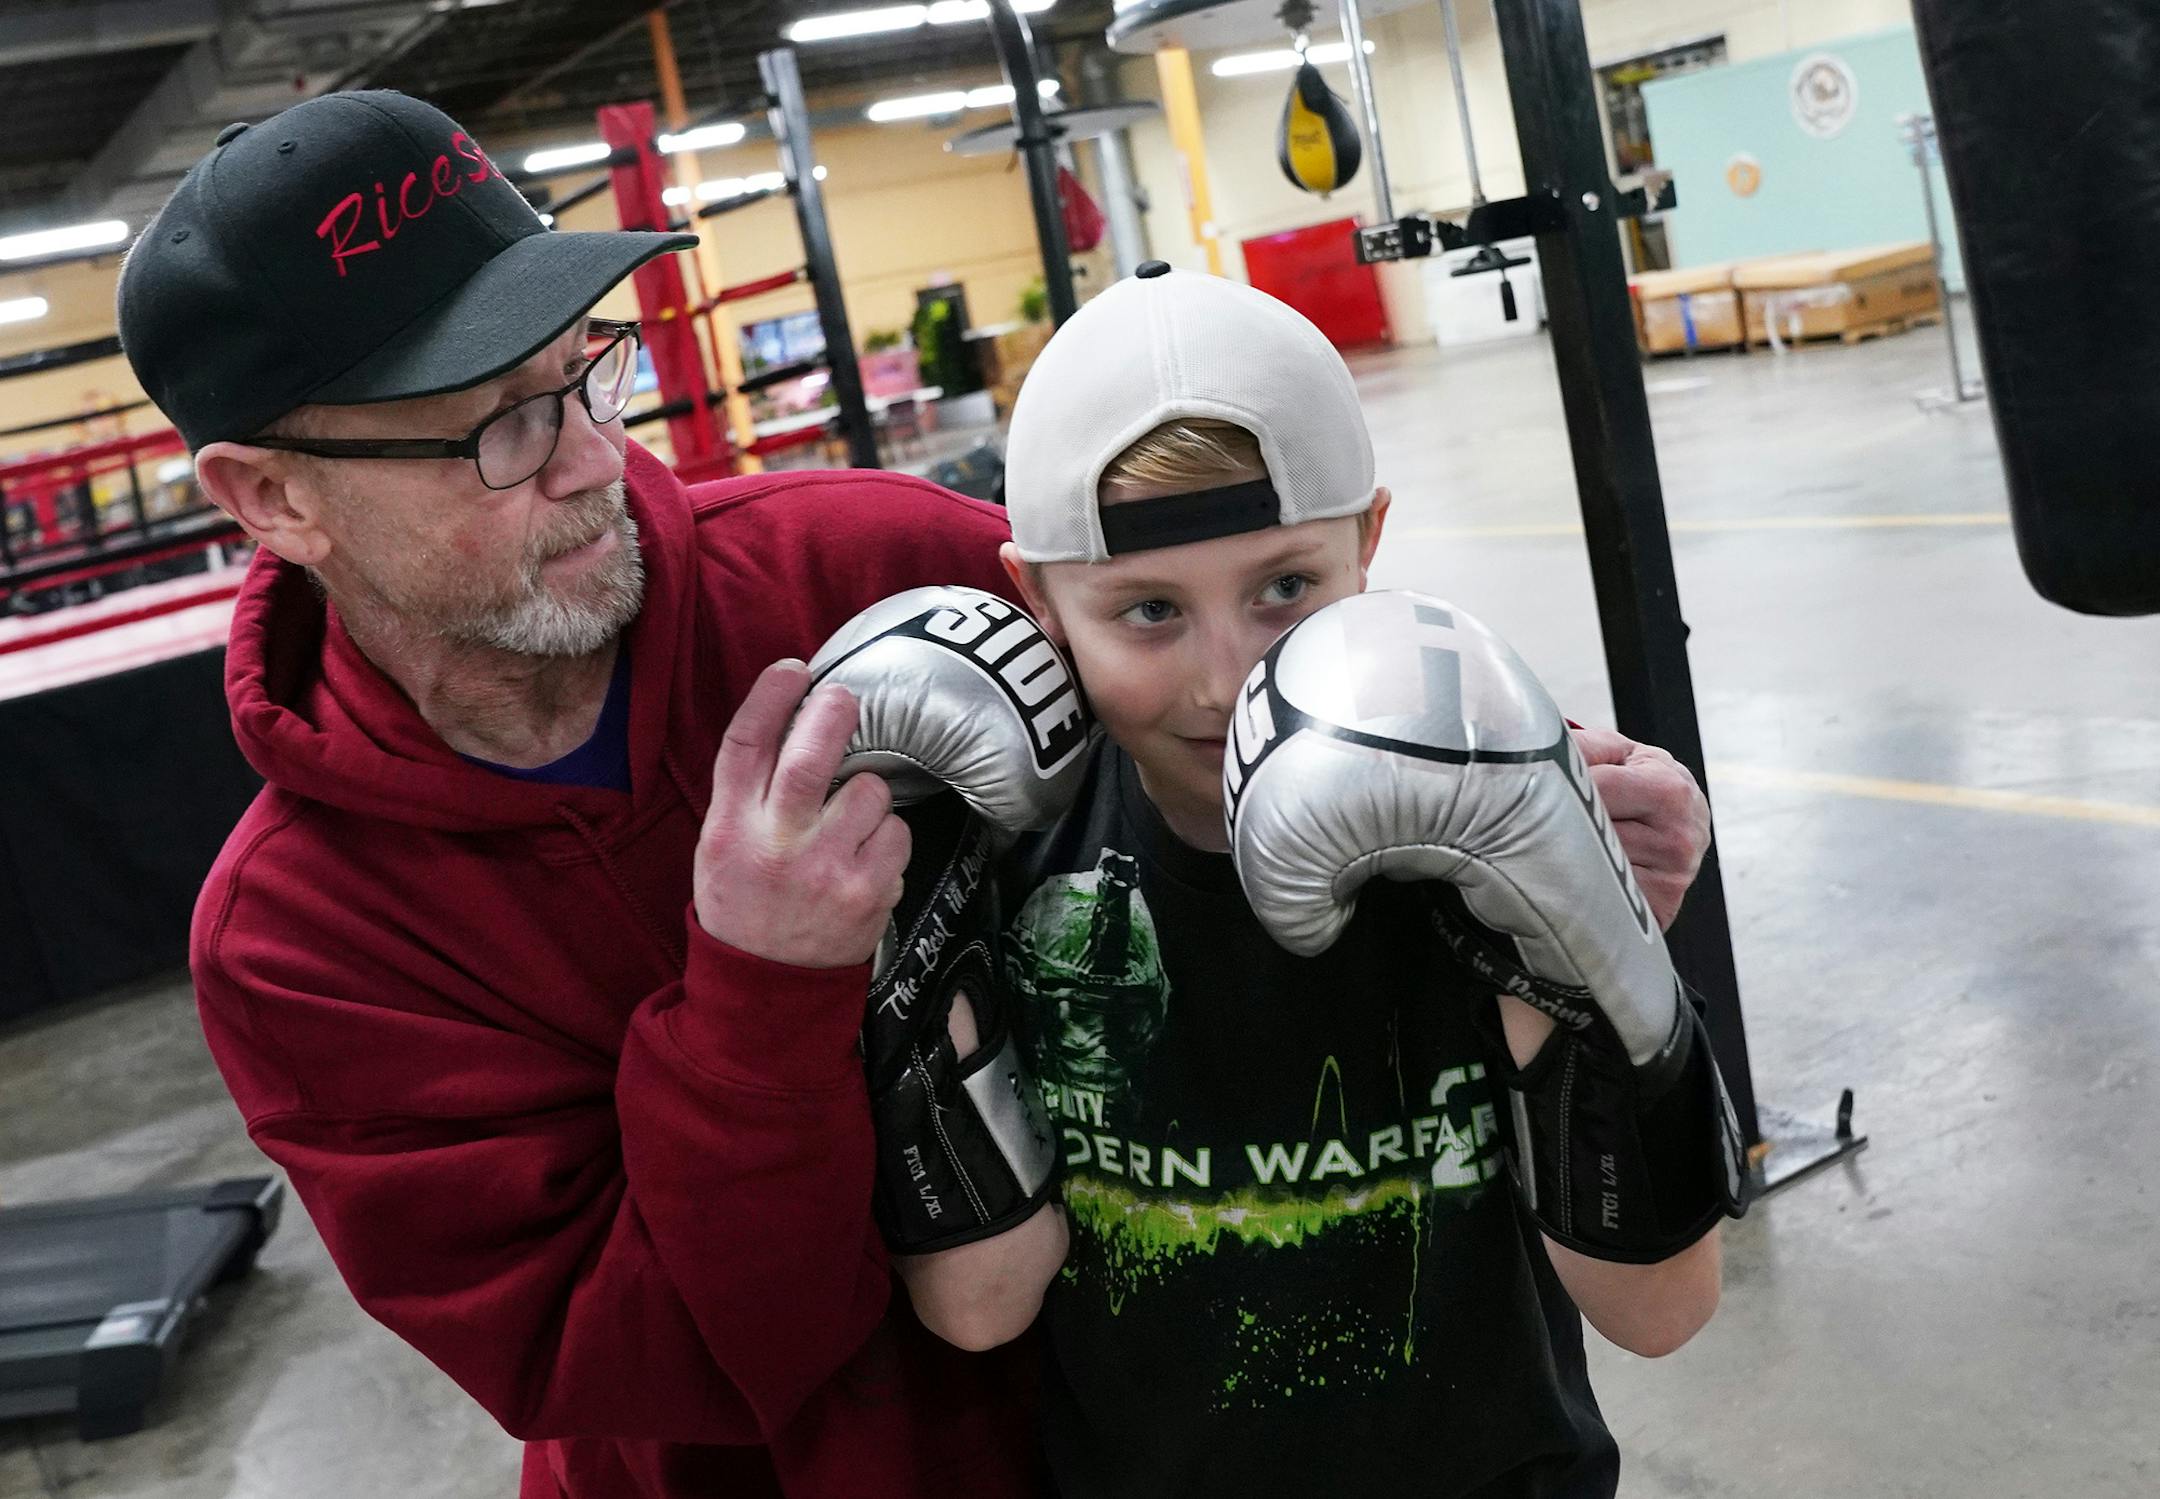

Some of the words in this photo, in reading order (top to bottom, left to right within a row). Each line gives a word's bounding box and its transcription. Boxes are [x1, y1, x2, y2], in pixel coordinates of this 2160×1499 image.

[924, 601, 1083, 750] SIDE
[878, 977, 920, 1020] The
[915, 912, 957, 983] Best
[1062, 1127, 1211, 1187] DERN
[919, 1184, 943, 1220] L/XL
